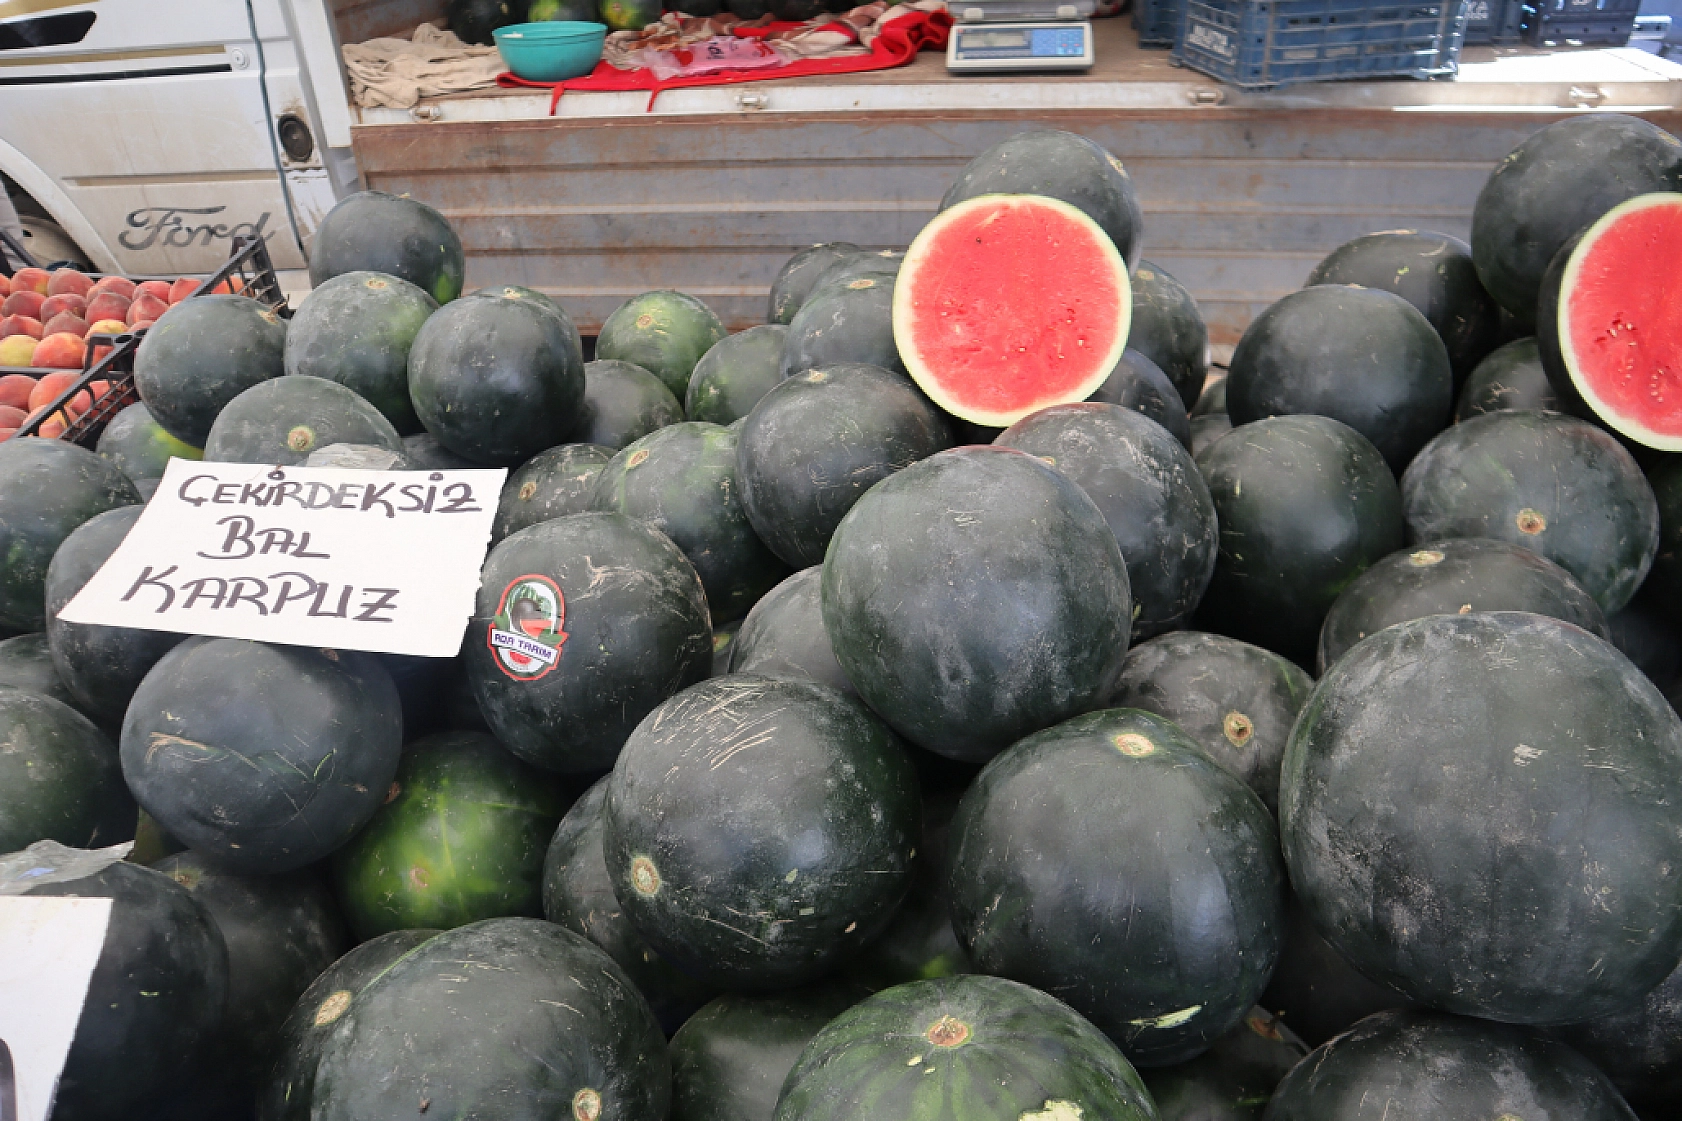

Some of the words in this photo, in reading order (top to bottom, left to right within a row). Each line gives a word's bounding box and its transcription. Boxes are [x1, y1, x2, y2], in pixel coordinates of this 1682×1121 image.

[118, 205, 275, 250] Ford
[196, 515, 330, 559] BAL
[120, 565, 400, 623] KARPUZ
